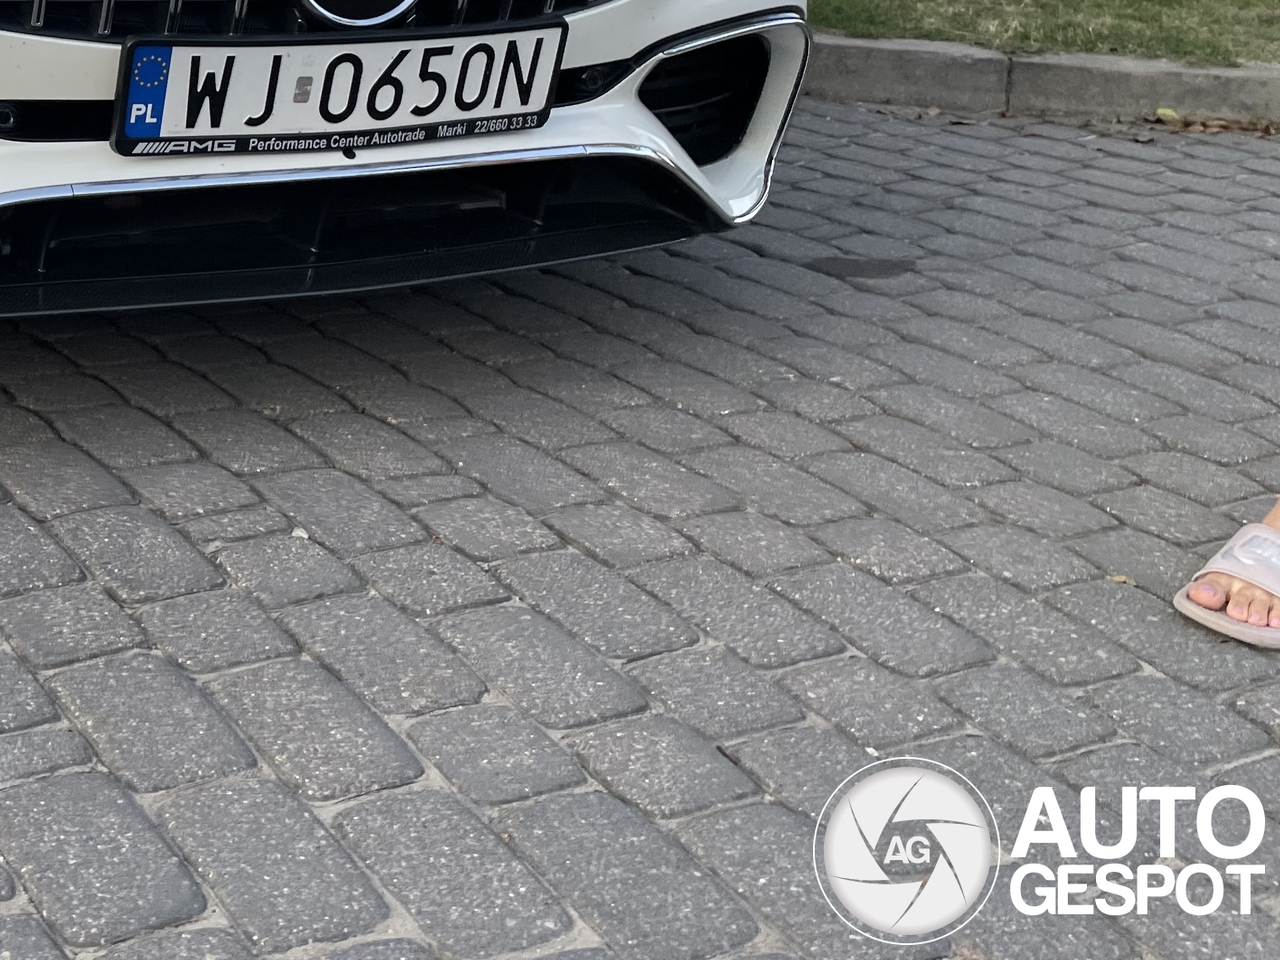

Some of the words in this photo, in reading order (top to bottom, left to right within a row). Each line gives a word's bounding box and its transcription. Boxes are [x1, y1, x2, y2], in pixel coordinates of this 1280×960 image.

[185, 54, 283, 130] WJ
[318, 37, 545, 124] 0650N
[129, 102, 158, 124] PL
[248, 136, 327, 152] Performance
[330, 134, 370, 149] Center
[370, 128, 426, 146] Autotrade
[437, 123, 467, 138] Marki
[474, 118, 509, 134] 22/660
[510, 116, 523, 130] 33
[525, 114, 538, 128] 33
